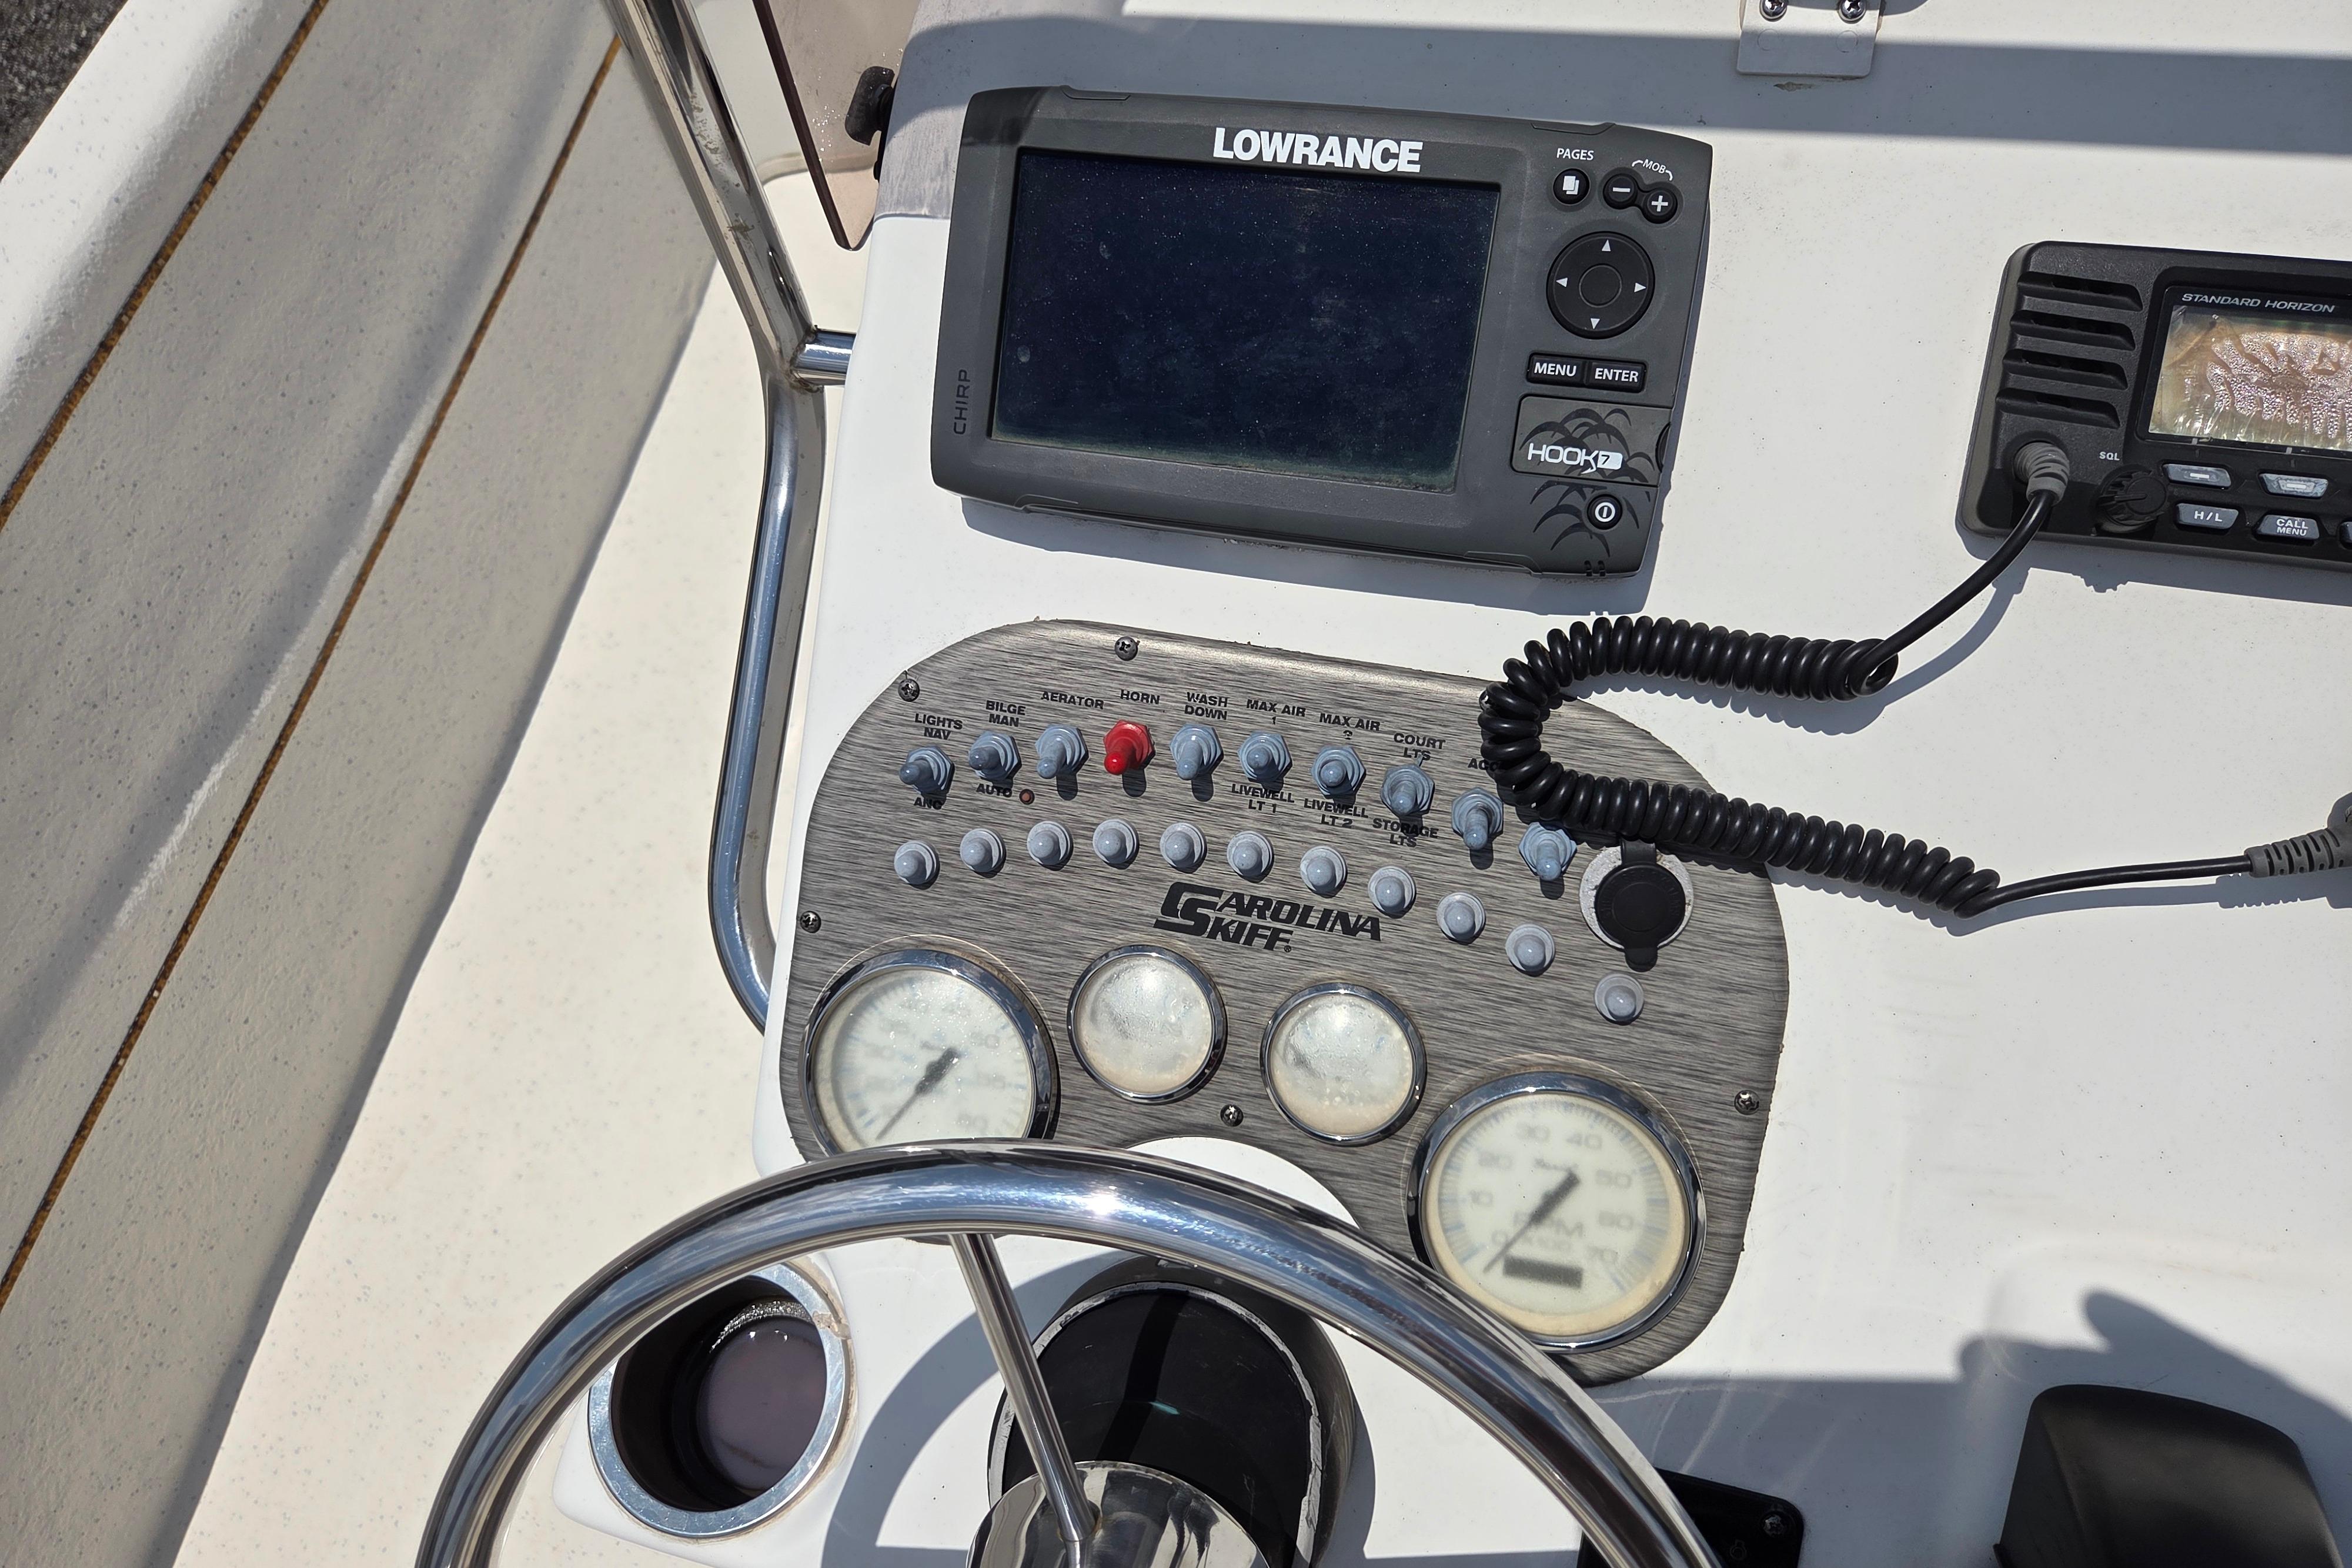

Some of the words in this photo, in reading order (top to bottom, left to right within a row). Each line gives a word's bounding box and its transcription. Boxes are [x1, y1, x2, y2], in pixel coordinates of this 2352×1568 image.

[1213, 127, 1424, 173] LOWRANCE
[1556, 148, 1594, 161] PAGES
[1642, 159, 1666, 174] MOB
[2181, 293, 2261, 307] STANDARD
[2265, 299, 2336, 313] HORIZON
[1534, 362, 1576, 377] MENU
[1595, 367, 1639, 382] ENTER
[953, 369, 970, 434] CHIRP
[2099, 450, 2120, 462] SQL
[2194, 510, 2223, 523] H/L
[2276, 518, 2308, 530] CALL
[2277, 527, 2307, 537] MENU
[1041, 690, 1104, 709] AERATOR
[1120, 688, 1160, 705] HORN
[1187, 691, 1228, 708] WASH
[985, 700, 1026, 716] BILGE
[1184, 705, 1227, 720] DOWN
[1246, 698, 1277, 713] MAX
[1281, 705, 1306, 717] AIR
[915, 713, 963, 730] LIGHTS
[988, 713, 1020, 727] MAN
[1319, 713, 1351, 727] MAX
[1355, 718, 1381, 731] AIR
[924, 727, 951, 740] NAV
[1394, 733, 1446, 750] COURT
[1402, 747, 1431, 761] LTS
[976, 783, 1013, 798] AUTO
[1231, 783, 1295, 803] LIVEWELL
[1248, 799, 1265, 811] LT
[1271, 803, 1277, 814] 1
[1304, 798, 1369, 818] LIVEWELL
[1321, 814, 1337, 826] LT
[1341, 818, 1353, 828] 2
[1372, 818, 1439, 839] STORAGE
[1389, 834, 1417, 848] LTS
[1161, 882, 1381, 941] CAROLINA
